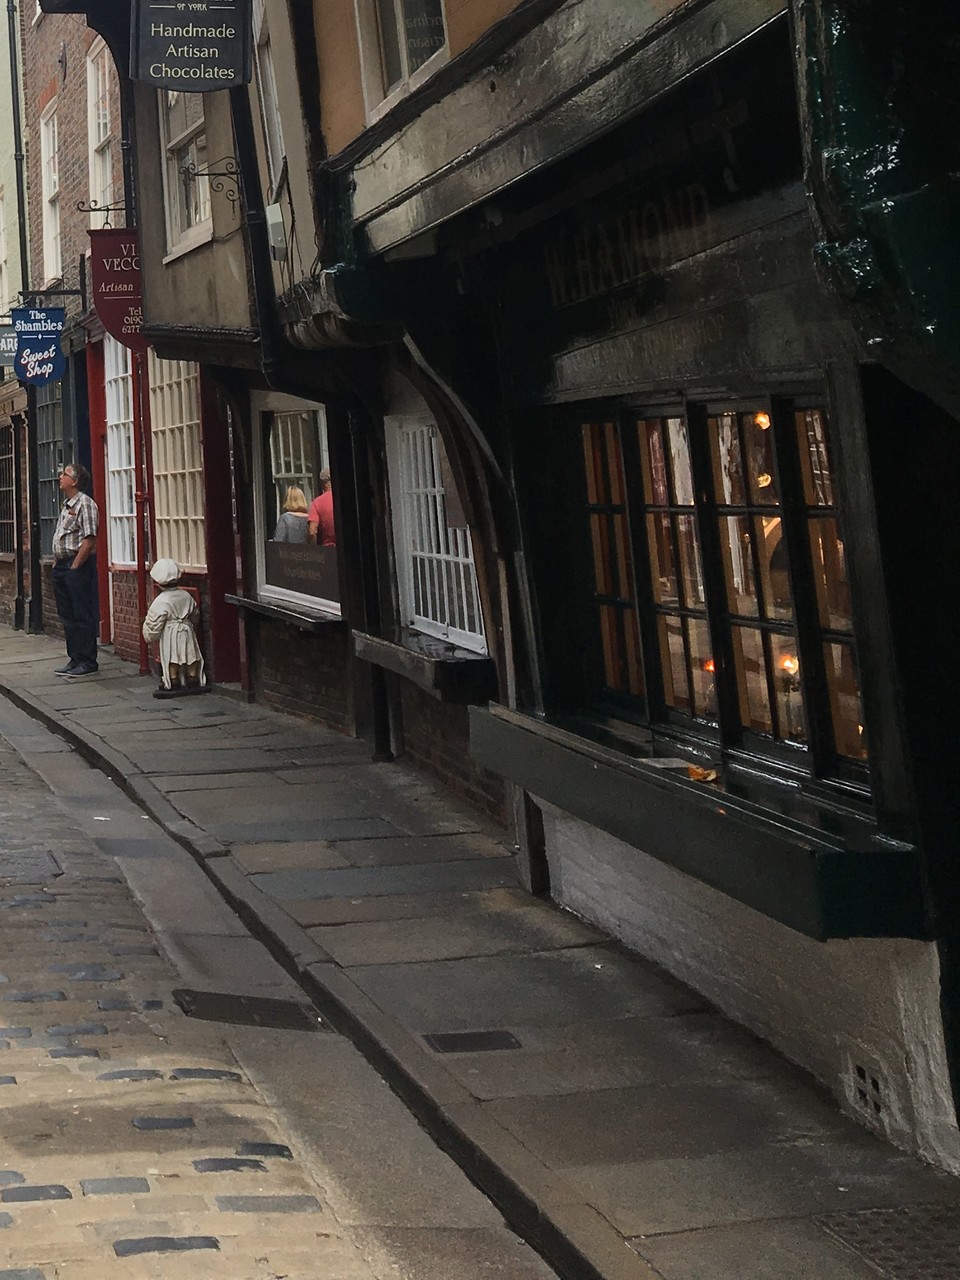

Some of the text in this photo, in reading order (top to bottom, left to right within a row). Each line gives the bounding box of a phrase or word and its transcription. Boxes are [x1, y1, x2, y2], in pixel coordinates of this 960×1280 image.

[188, 3, 208, 12] YORK
[151, 23, 236, 38] Handmade
[166, 44, 219, 58] Artisan
[149, 63, 235, 80] Chocolates
[120, 243, 140, 256] VI
[99, 281, 134, 293] Artisan
[29, 310, 46, 319] The
[15, 320, 63, 332] Shambles
[21, 344, 57, 365] Sweet
[26, 360, 54, 379] Shop
